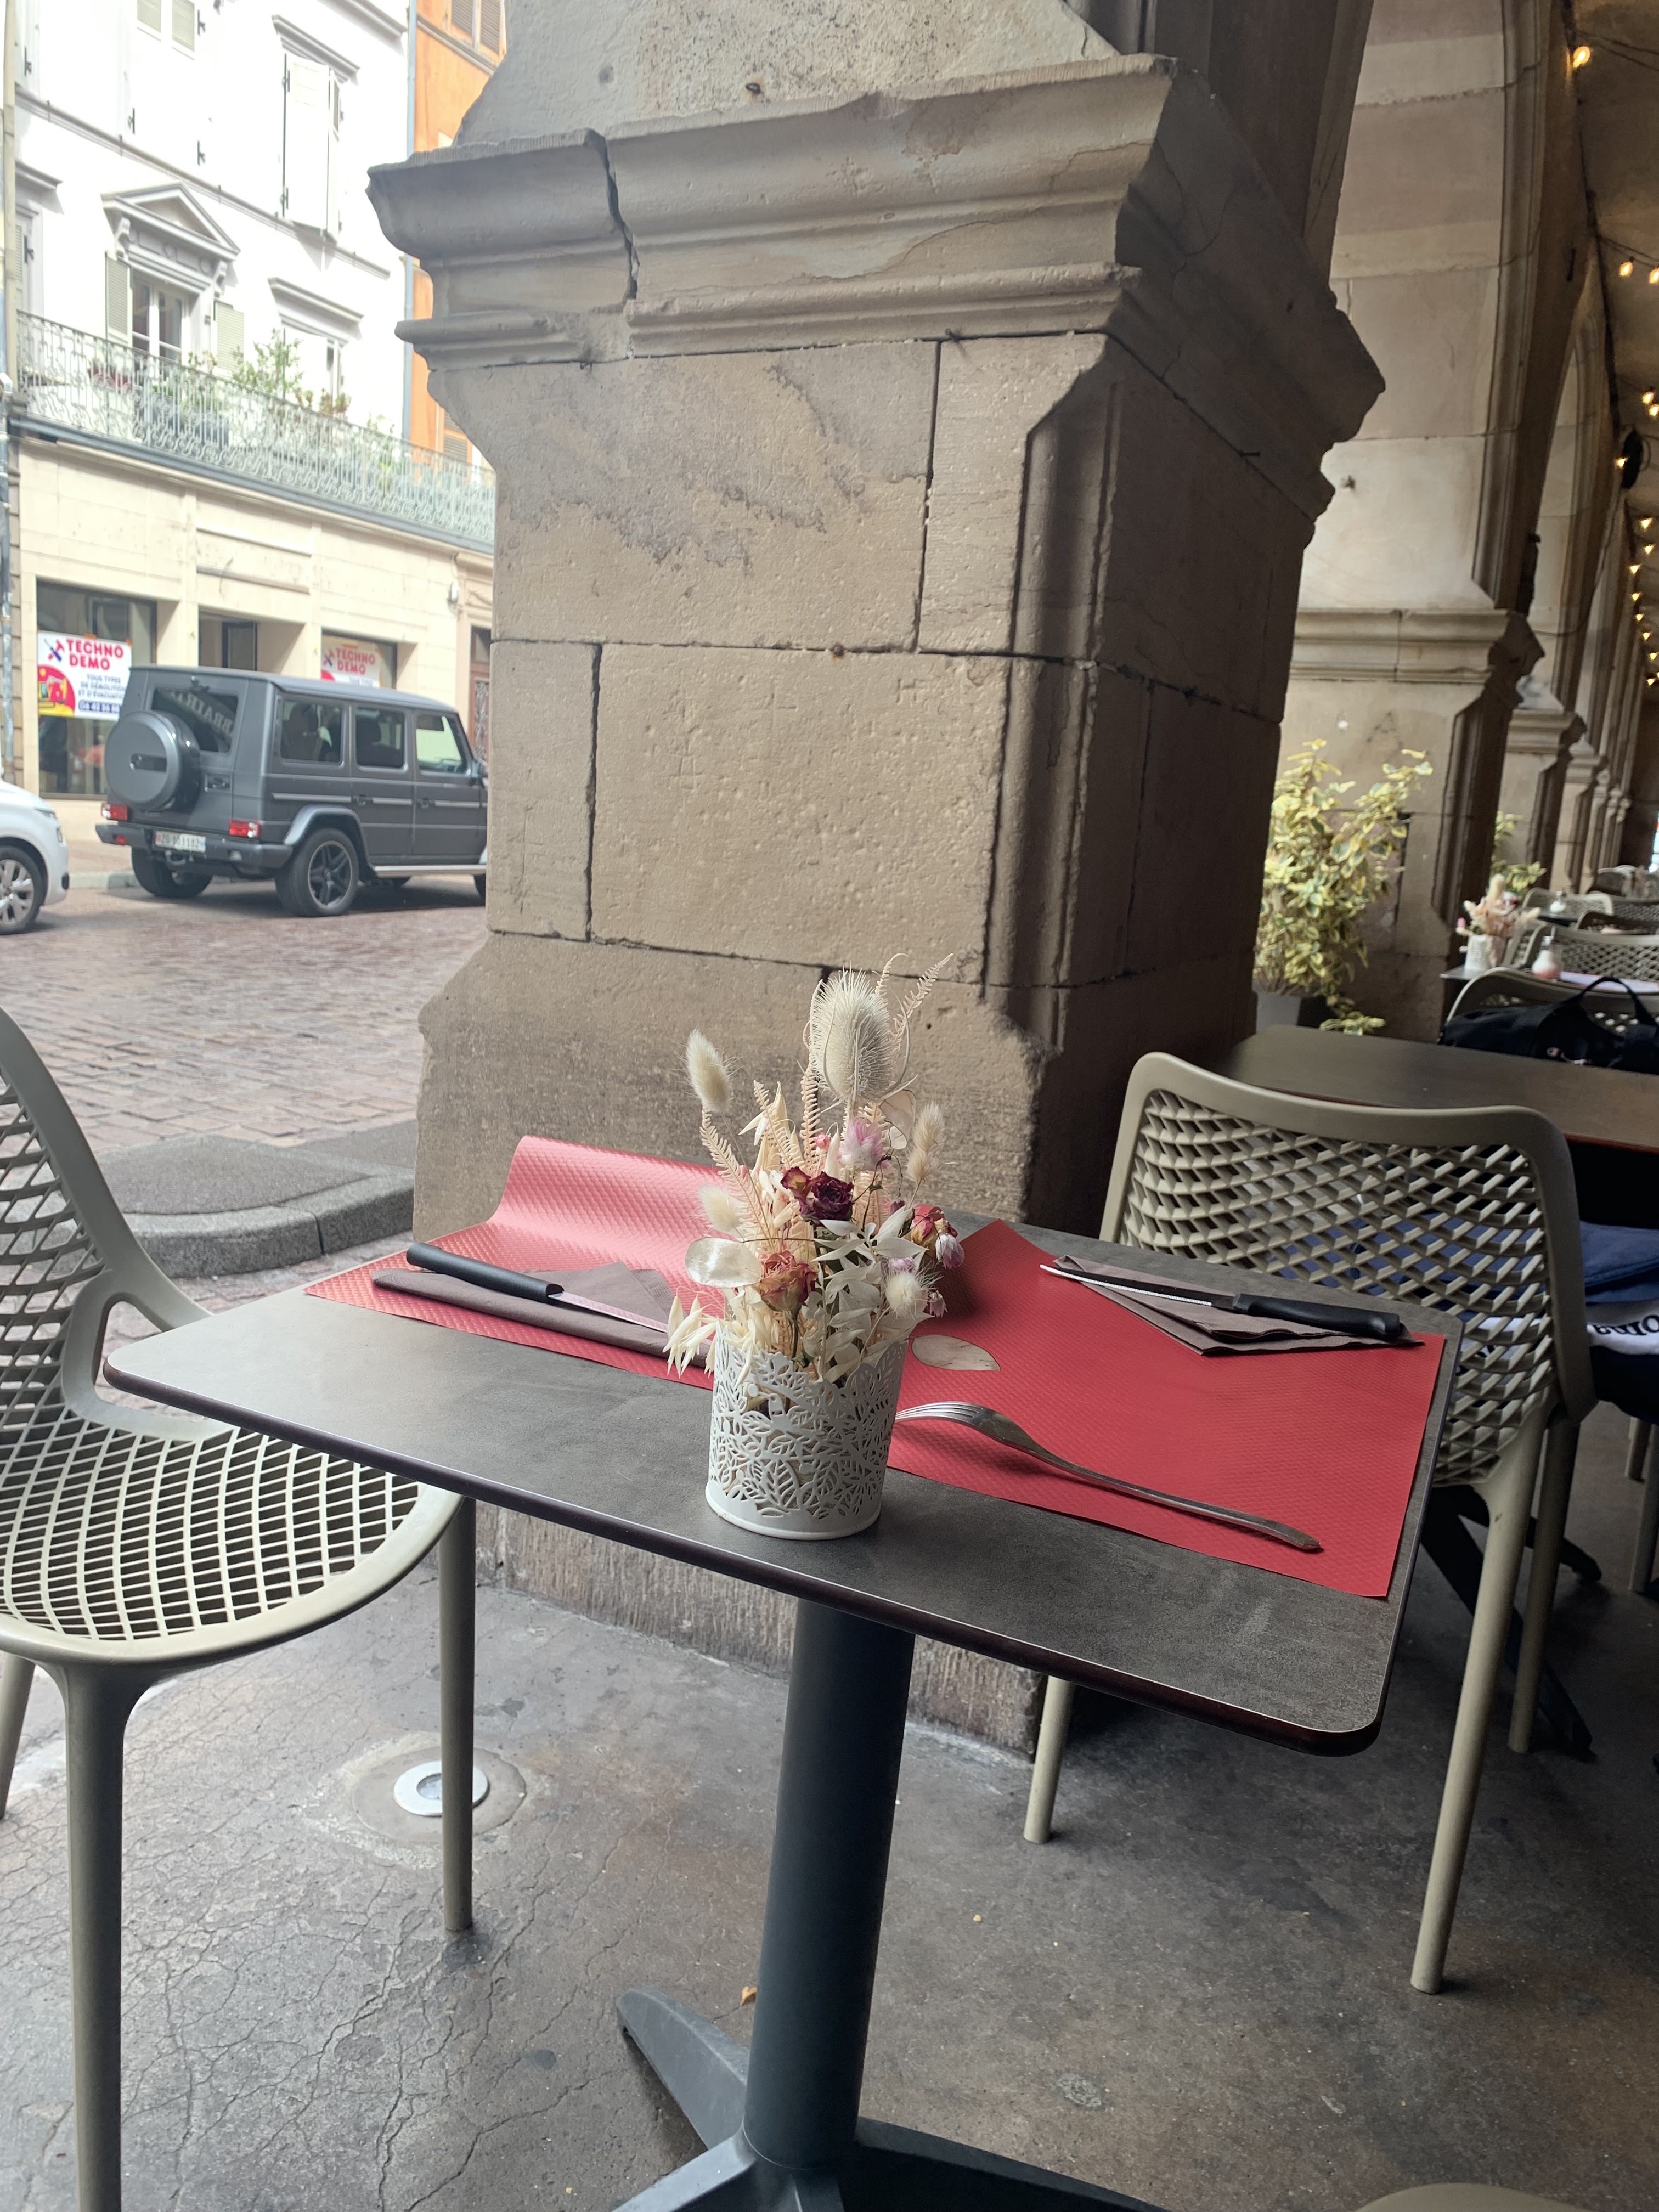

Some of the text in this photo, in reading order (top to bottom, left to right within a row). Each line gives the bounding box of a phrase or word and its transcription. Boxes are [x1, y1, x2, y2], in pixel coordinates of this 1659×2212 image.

[66, 639, 123, 658] TECHNO
[336, 648, 375, 664] TECHNO
[70, 655, 110, 670] DEMO
[337, 660, 365, 674] DEMO
